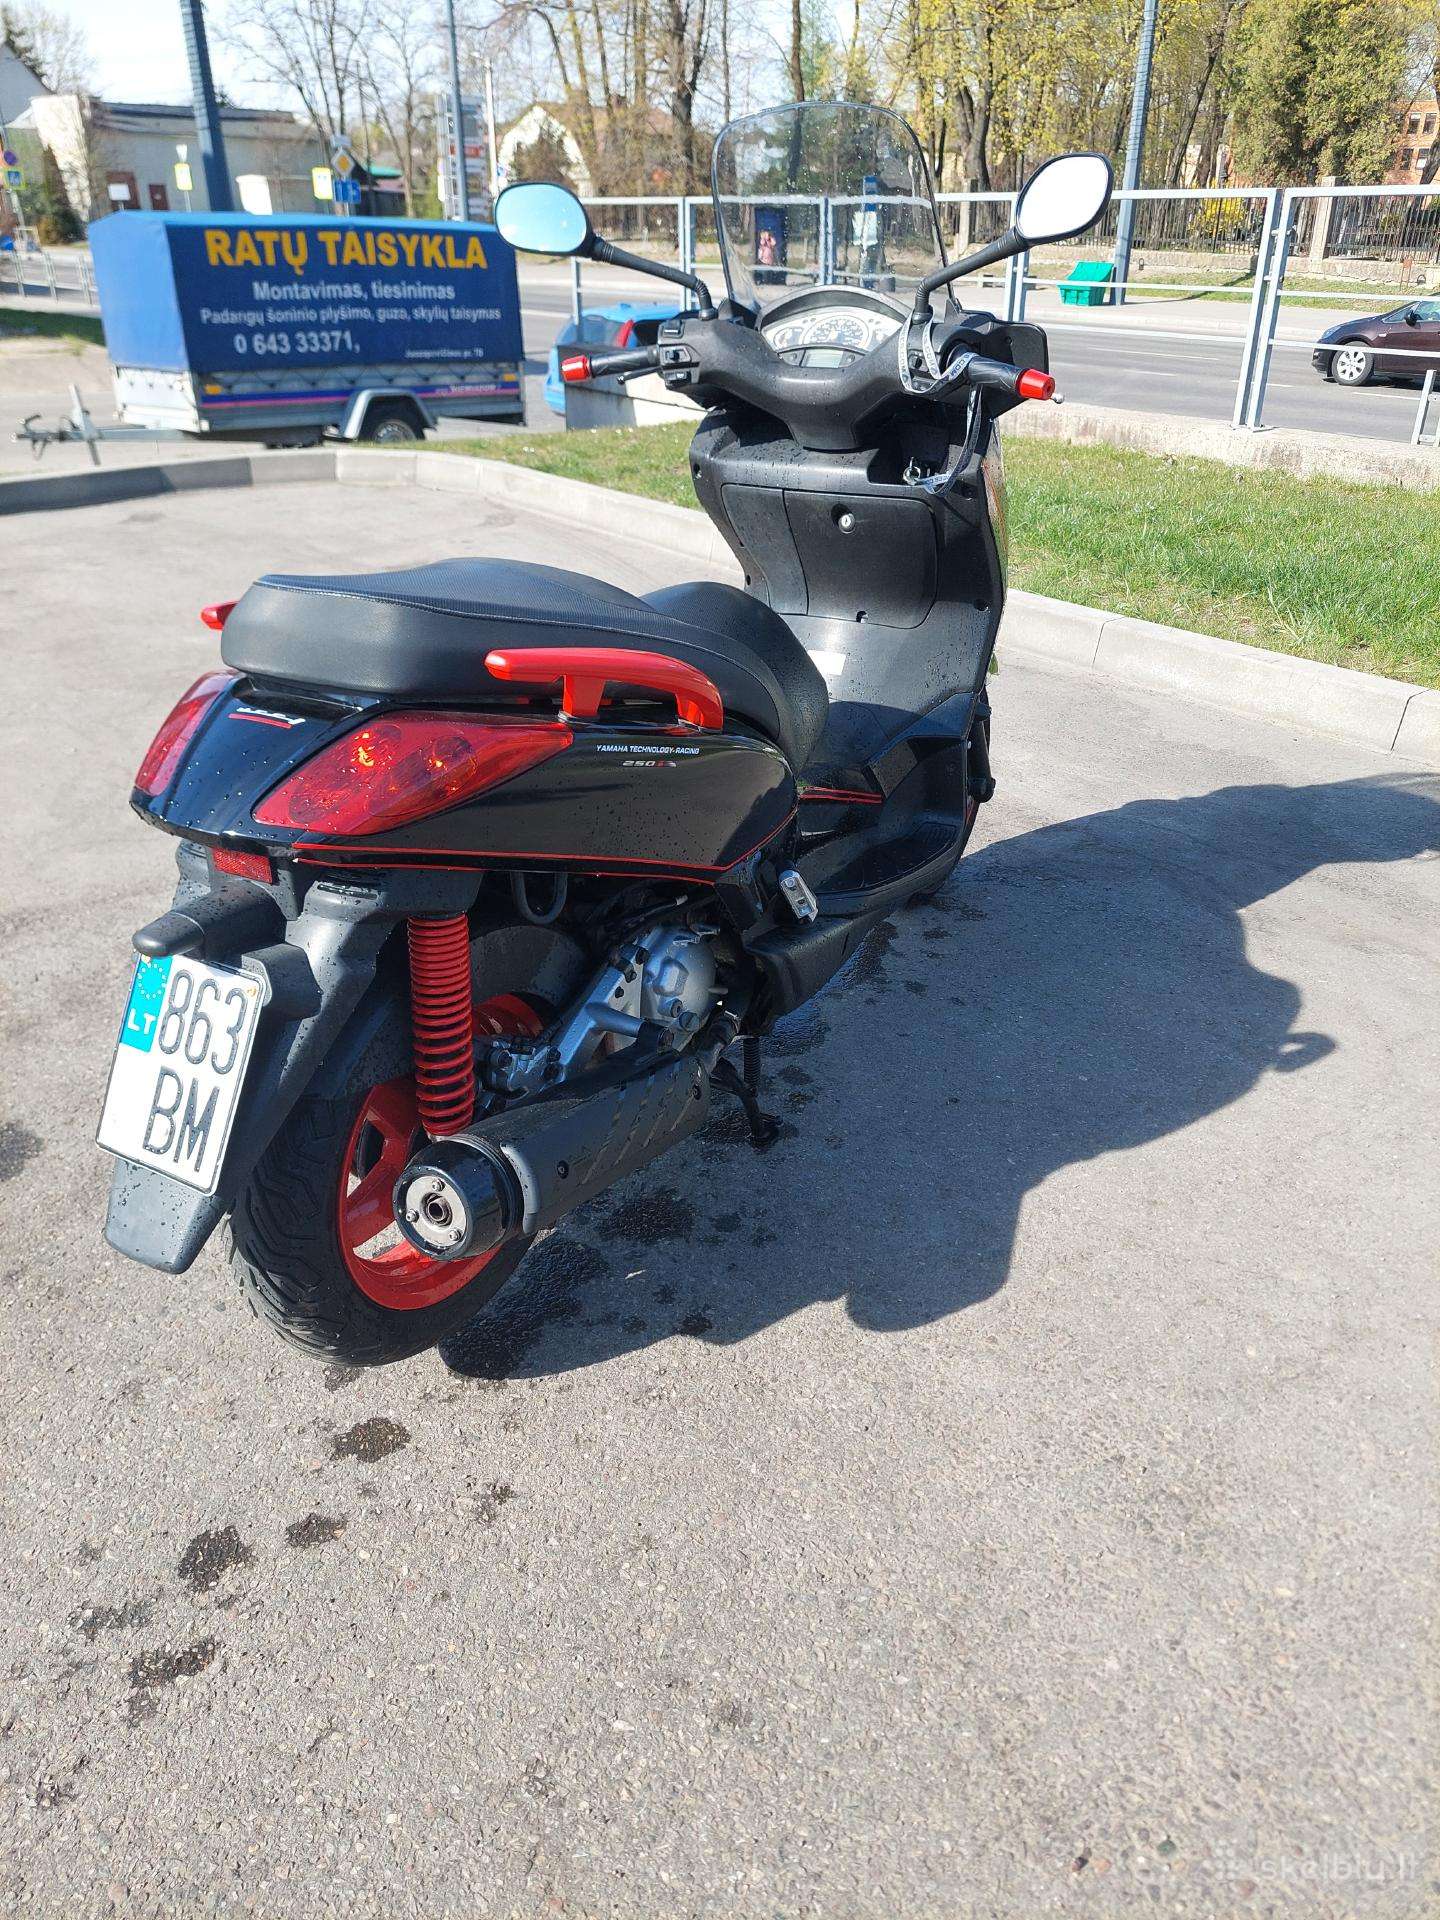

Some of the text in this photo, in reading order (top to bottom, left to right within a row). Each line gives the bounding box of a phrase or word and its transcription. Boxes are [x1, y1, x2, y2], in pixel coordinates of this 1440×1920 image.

[204, 229, 488, 275] RATŲ TAISYKLA
[252, 279, 456, 300] Montavimas, tiesinimas
[200, 307, 265, 327] Padangų
[450, 306, 501, 323] taisymas
[233, 333, 248, 354] 0
[252, 332, 291, 355] 643
[597, 744, 628, 752] YAMAHA
[127, 1008, 157, 1035] LT
[158, 969, 248, 1075] 863
[142, 1065, 220, 1172] BM
